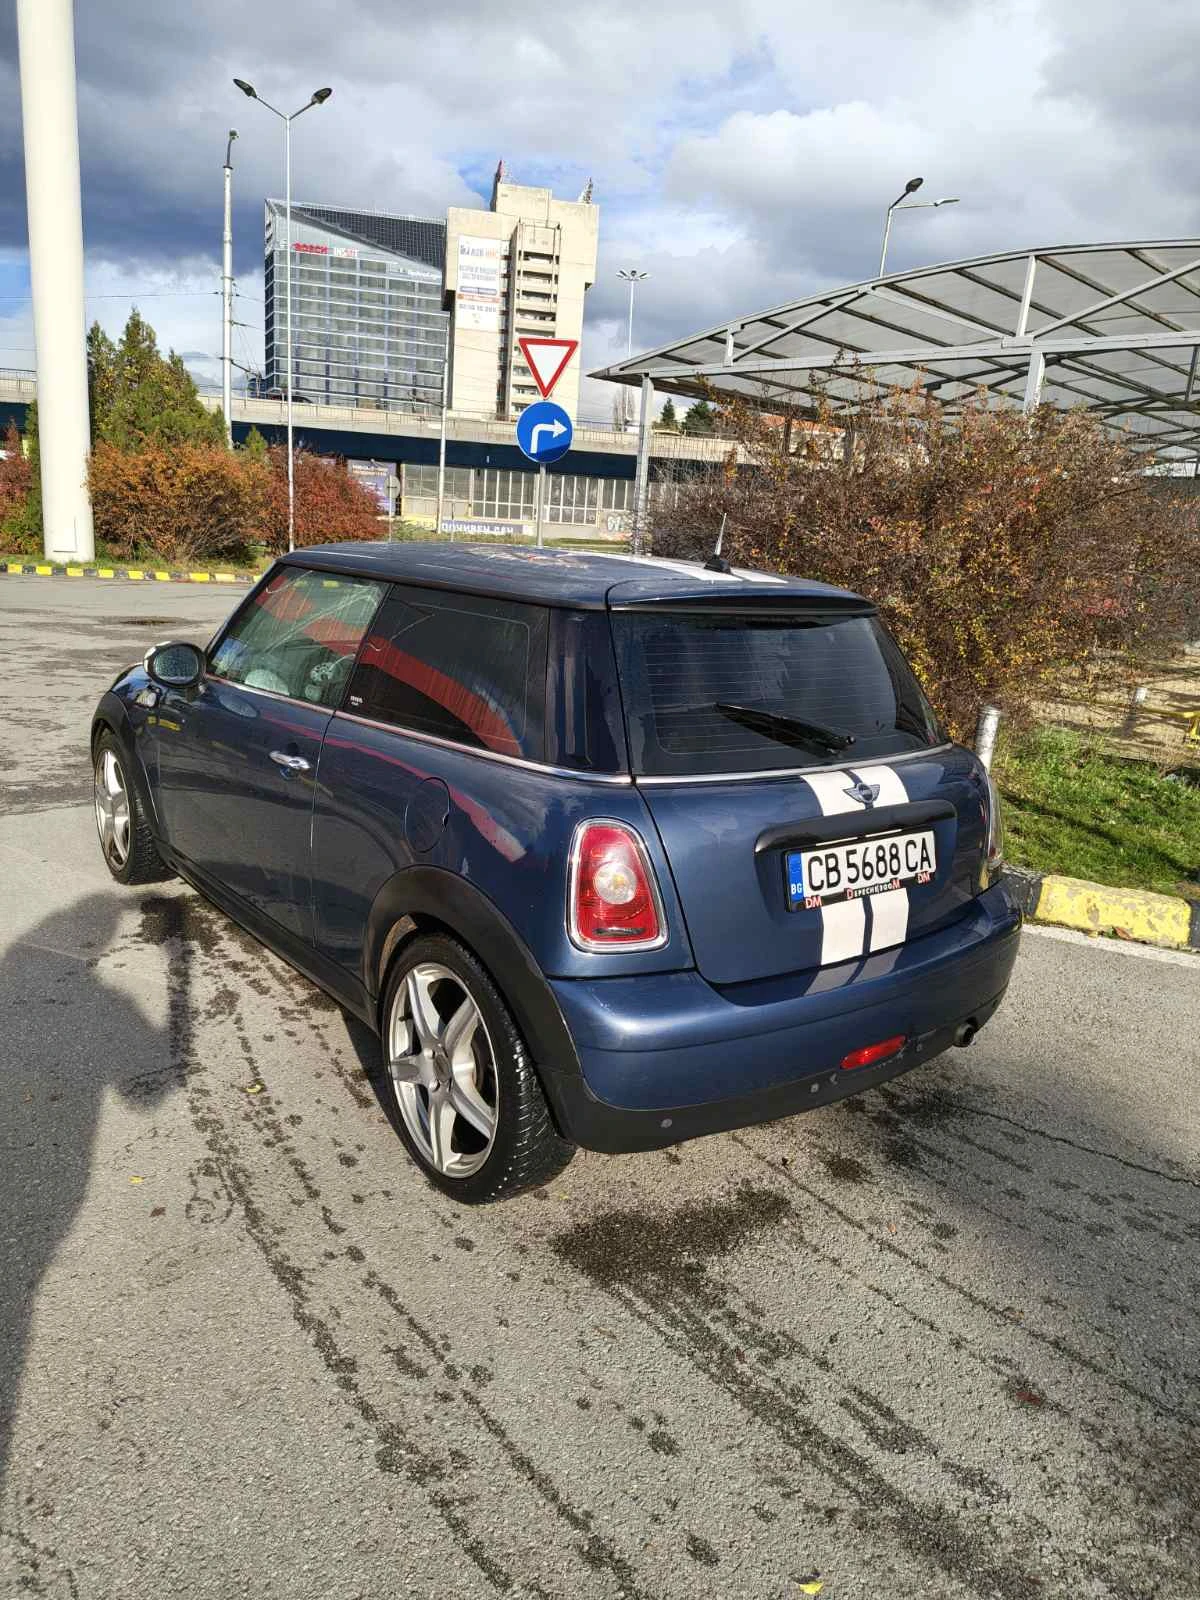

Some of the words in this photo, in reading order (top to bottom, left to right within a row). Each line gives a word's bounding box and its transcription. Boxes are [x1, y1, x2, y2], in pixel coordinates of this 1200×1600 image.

[917, 871, 932, 884] DM
[790, 883, 802, 895] BG
[805, 896, 823, 909] DM
